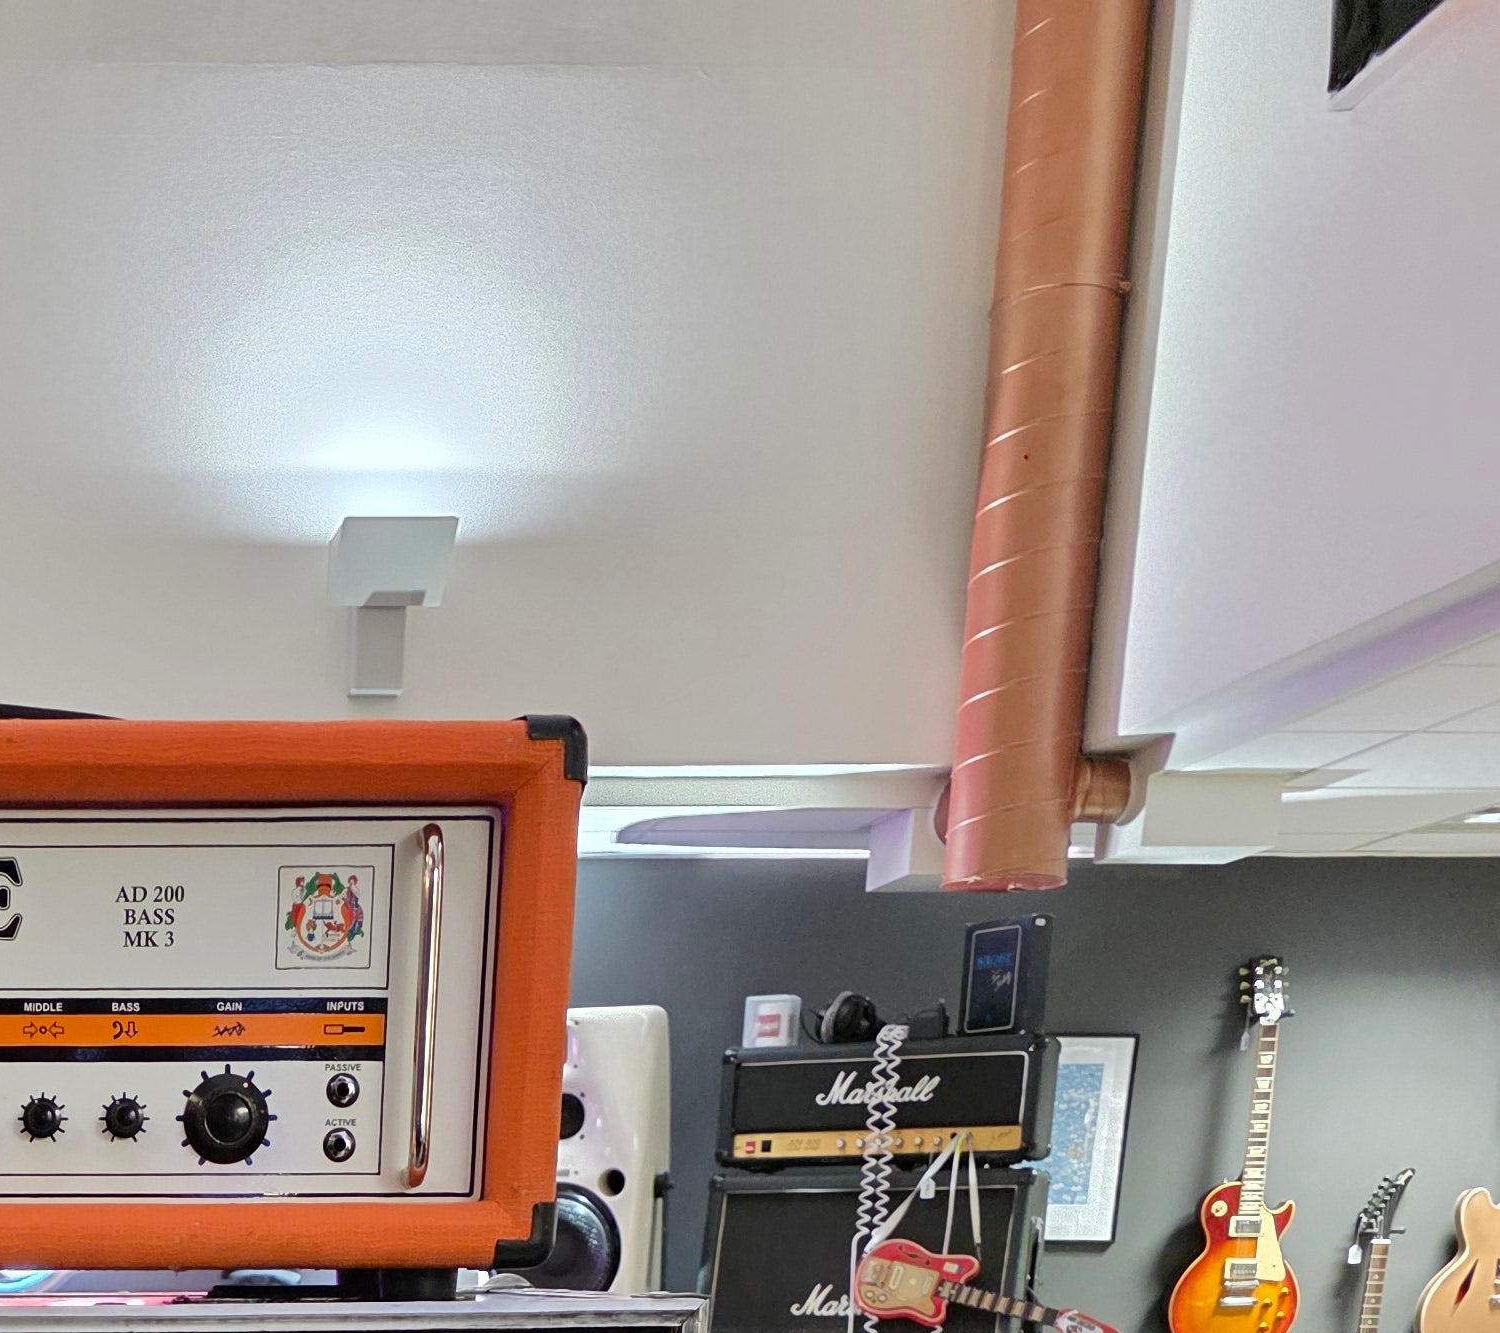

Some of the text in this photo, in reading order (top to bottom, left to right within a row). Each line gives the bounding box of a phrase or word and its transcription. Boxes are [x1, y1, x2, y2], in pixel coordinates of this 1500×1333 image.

[115, 885, 185, 903] AD 200
[123, 908, 175, 925] BASS
[123, 931, 175, 947] MK 3
[23, 1002, 63, 1012] MIDDLE
[111, 1002, 140, 1012] BASS
[216, 1001, 243, 1012] GAIN
[326, 1001, 365, 1012] INPUTS
[324, 1063, 362, 1072] PASSIVE
[324, 1118, 357, 1127] ACTIVE
